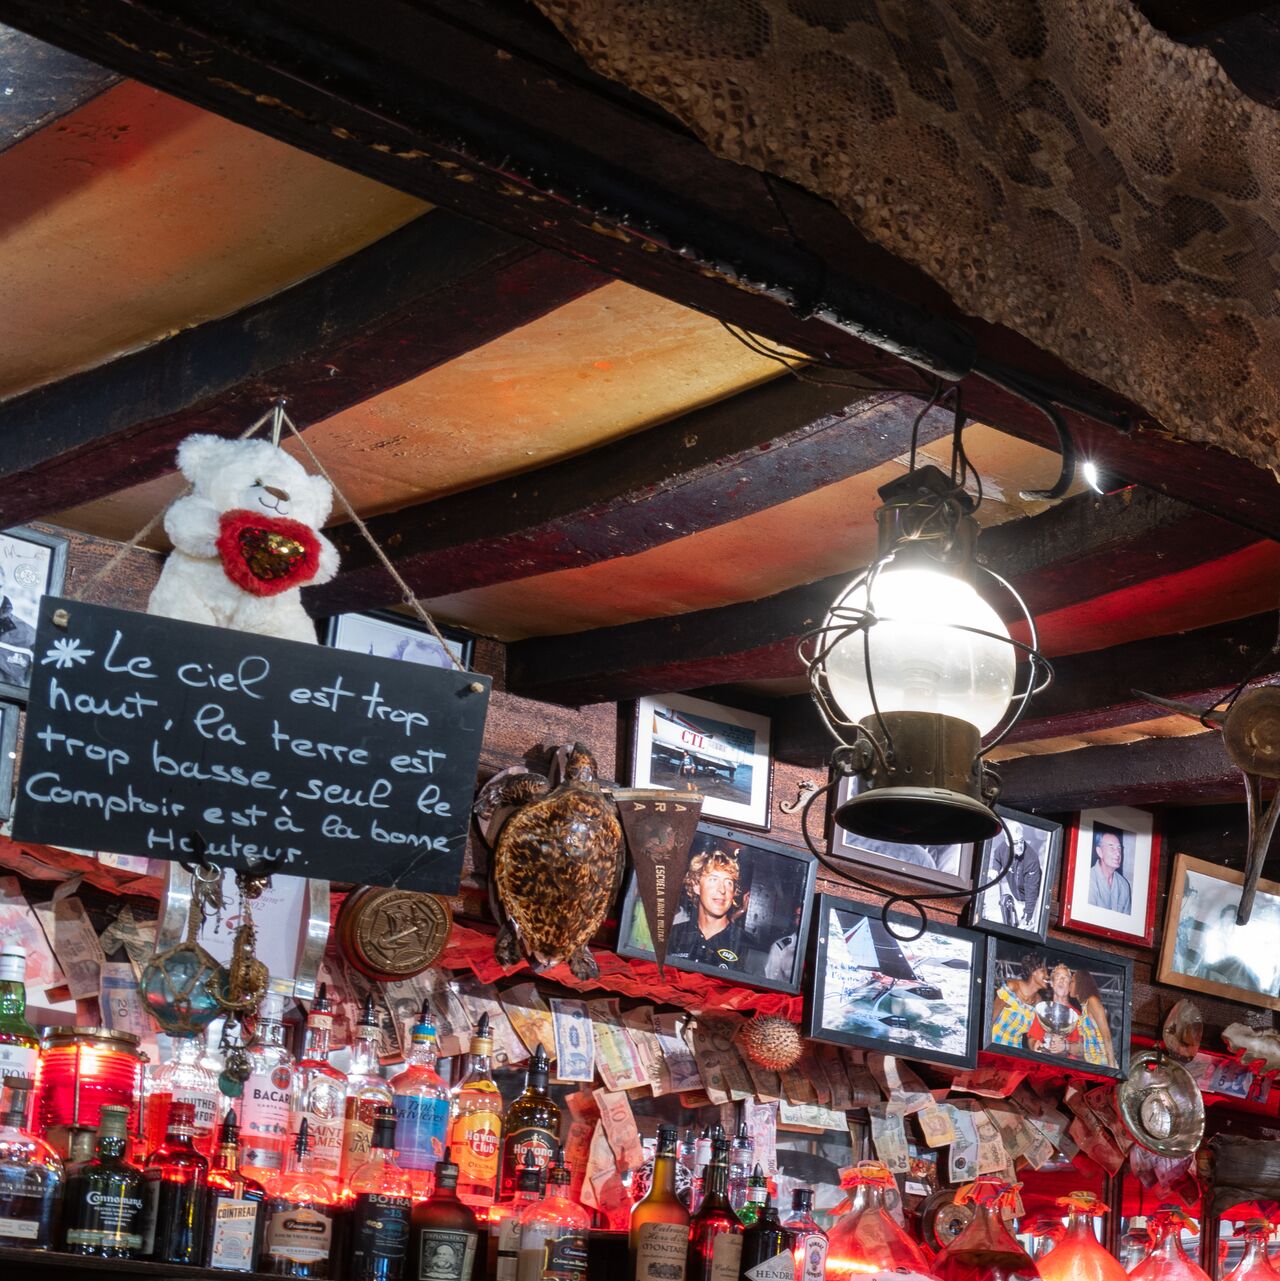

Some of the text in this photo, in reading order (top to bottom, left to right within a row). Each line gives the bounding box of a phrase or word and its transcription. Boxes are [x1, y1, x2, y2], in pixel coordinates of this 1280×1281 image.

[105, 630, 430, 736] Le ciel est trop
[194, 704, 246, 747] la
[271, 719, 371, 766] terre
[390, 748, 447, 775] est
[681, 729, 705, 750] CTL
[37, 724, 130, 775] trop
[296, 777, 393, 810] seul
[418, 784, 452, 817] le
[24, 770, 452, 854] Comptoir est à la bonne
[655, 865, 666, 897] ESCUELA
[408, 1101, 437, 1113] Trois
[308, 1124, 343, 1139] SAINT
[473, 1141, 495, 1153] Club
[217, 1206, 256, 1220] COINTREAU
